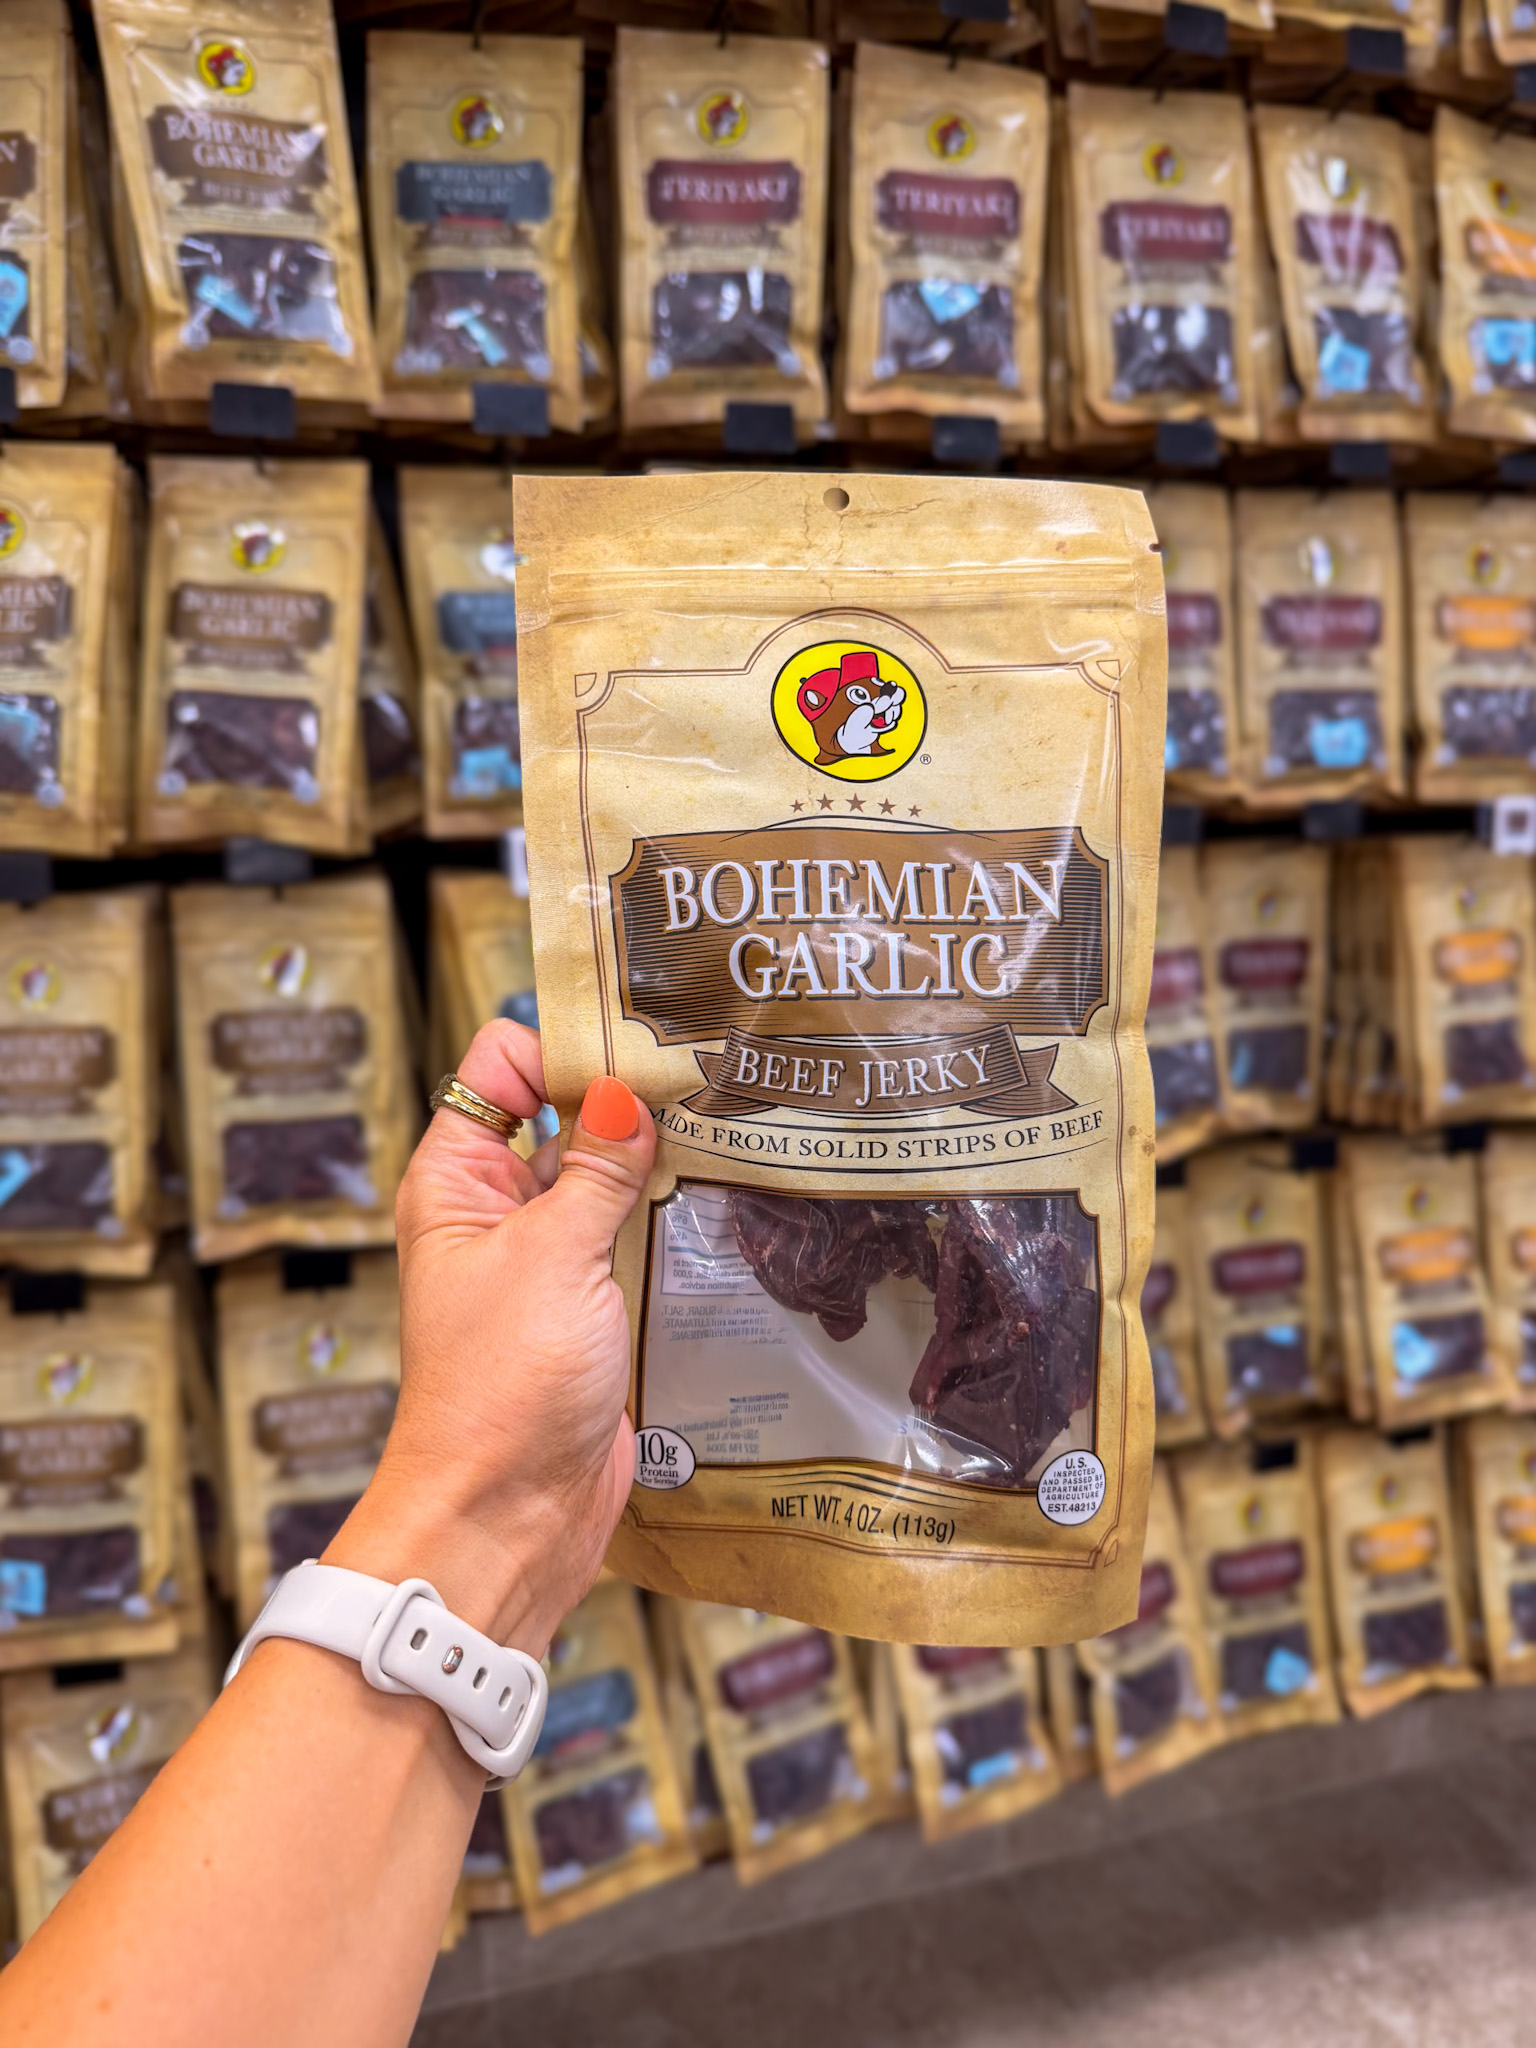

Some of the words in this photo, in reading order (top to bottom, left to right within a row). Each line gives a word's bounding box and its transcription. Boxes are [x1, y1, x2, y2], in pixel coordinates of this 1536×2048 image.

[193, 142, 296, 178] GARLIC
[660, 174, 789, 204] TERIYAKI
[658, 858, 1065, 931] BOHEMIAN
[728, 932, 1011, 999] GARLIC
[733, 1046, 846, 1098] BEEF
[854, 1044, 992, 1107] JERKY
[711, 1126, 791, 1155] FROM
[799, 1138, 888, 1159] SOLID
[897, 1133, 996, 1159] STRIPS
[1004, 1126, 1041, 1148] OF
[1049, 1110, 1104, 1141] BEEF
[639, 1432, 678, 1466] 10g
[640, 1466, 679, 1478] Protein
[1053, 1468, 1096, 1477] INSPECTED
[1065, 1456, 1087, 1469] U.S.
[654, 1476, 679, 1485] Serving
[1041, 1484, 1092, 1493] DEPARTMENT
[1062, 1476, 1092, 1485] PASSED
[1045, 1491, 1099, 1501] AGRICULTURE
[1047, 1502, 1096, 1513] EST.48213
[771, 1494, 808, 1517] NET
[814, 1494, 842, 1525] WT.
[844, 1501, 854, 1528] 4
[857, 1504, 884, 1534] OZ.
[893, 1512, 956, 1545] (113g)
